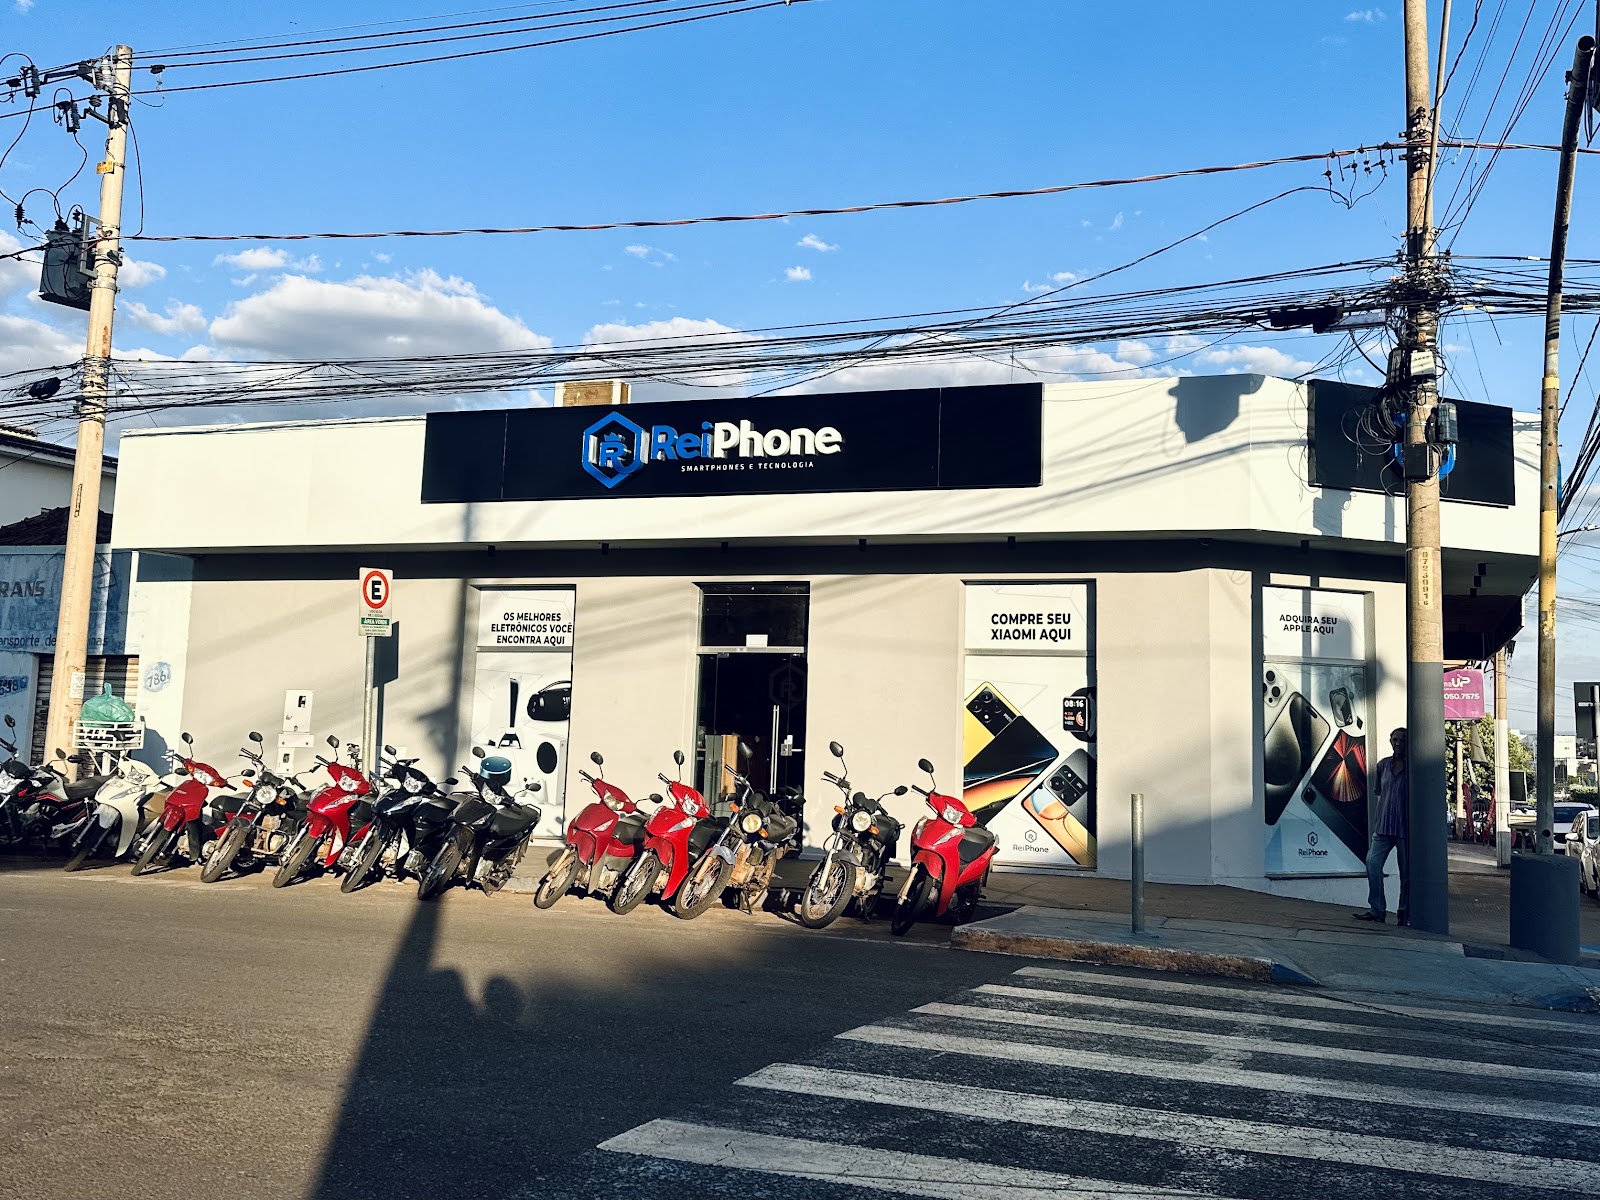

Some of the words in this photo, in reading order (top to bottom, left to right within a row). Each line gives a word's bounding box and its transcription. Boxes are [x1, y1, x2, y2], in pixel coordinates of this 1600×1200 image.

[651, 419, 844, 461] ReiPhone
[680, 463, 745, 472] SMARTPHONES
[758, 461, 814, 470] TECNOLOGIA
[371, 580, 382, 600] E
[503, 612, 515, 621] OS
[516, 612, 562, 621] MELHORES
[991, 613, 1043, 625] COMPRE
[1047, 613, 1071, 625] SEU
[1279, 614, 1319, 624] ADQUIRA
[1321, 616, 1337, 625] SEU
[491, 621, 547, 633] ELETRÔNICOS
[549, 621, 572, 633] VOCÊ
[1283, 624, 1311, 633] APPLE
[1313, 625, 1334, 635] AQUI
[496, 635, 541, 644] ENCONTRA
[543, 636, 565, 646] AQUI
[991, 628, 1036, 640] XIAOMI
[1039, 628, 1071, 642] AQUI
[1064, 699, 1084, 708] 08:16
[1013, 844, 1050, 853] ReiPhone
[1298, 848, 1328, 856] ReiPhone
